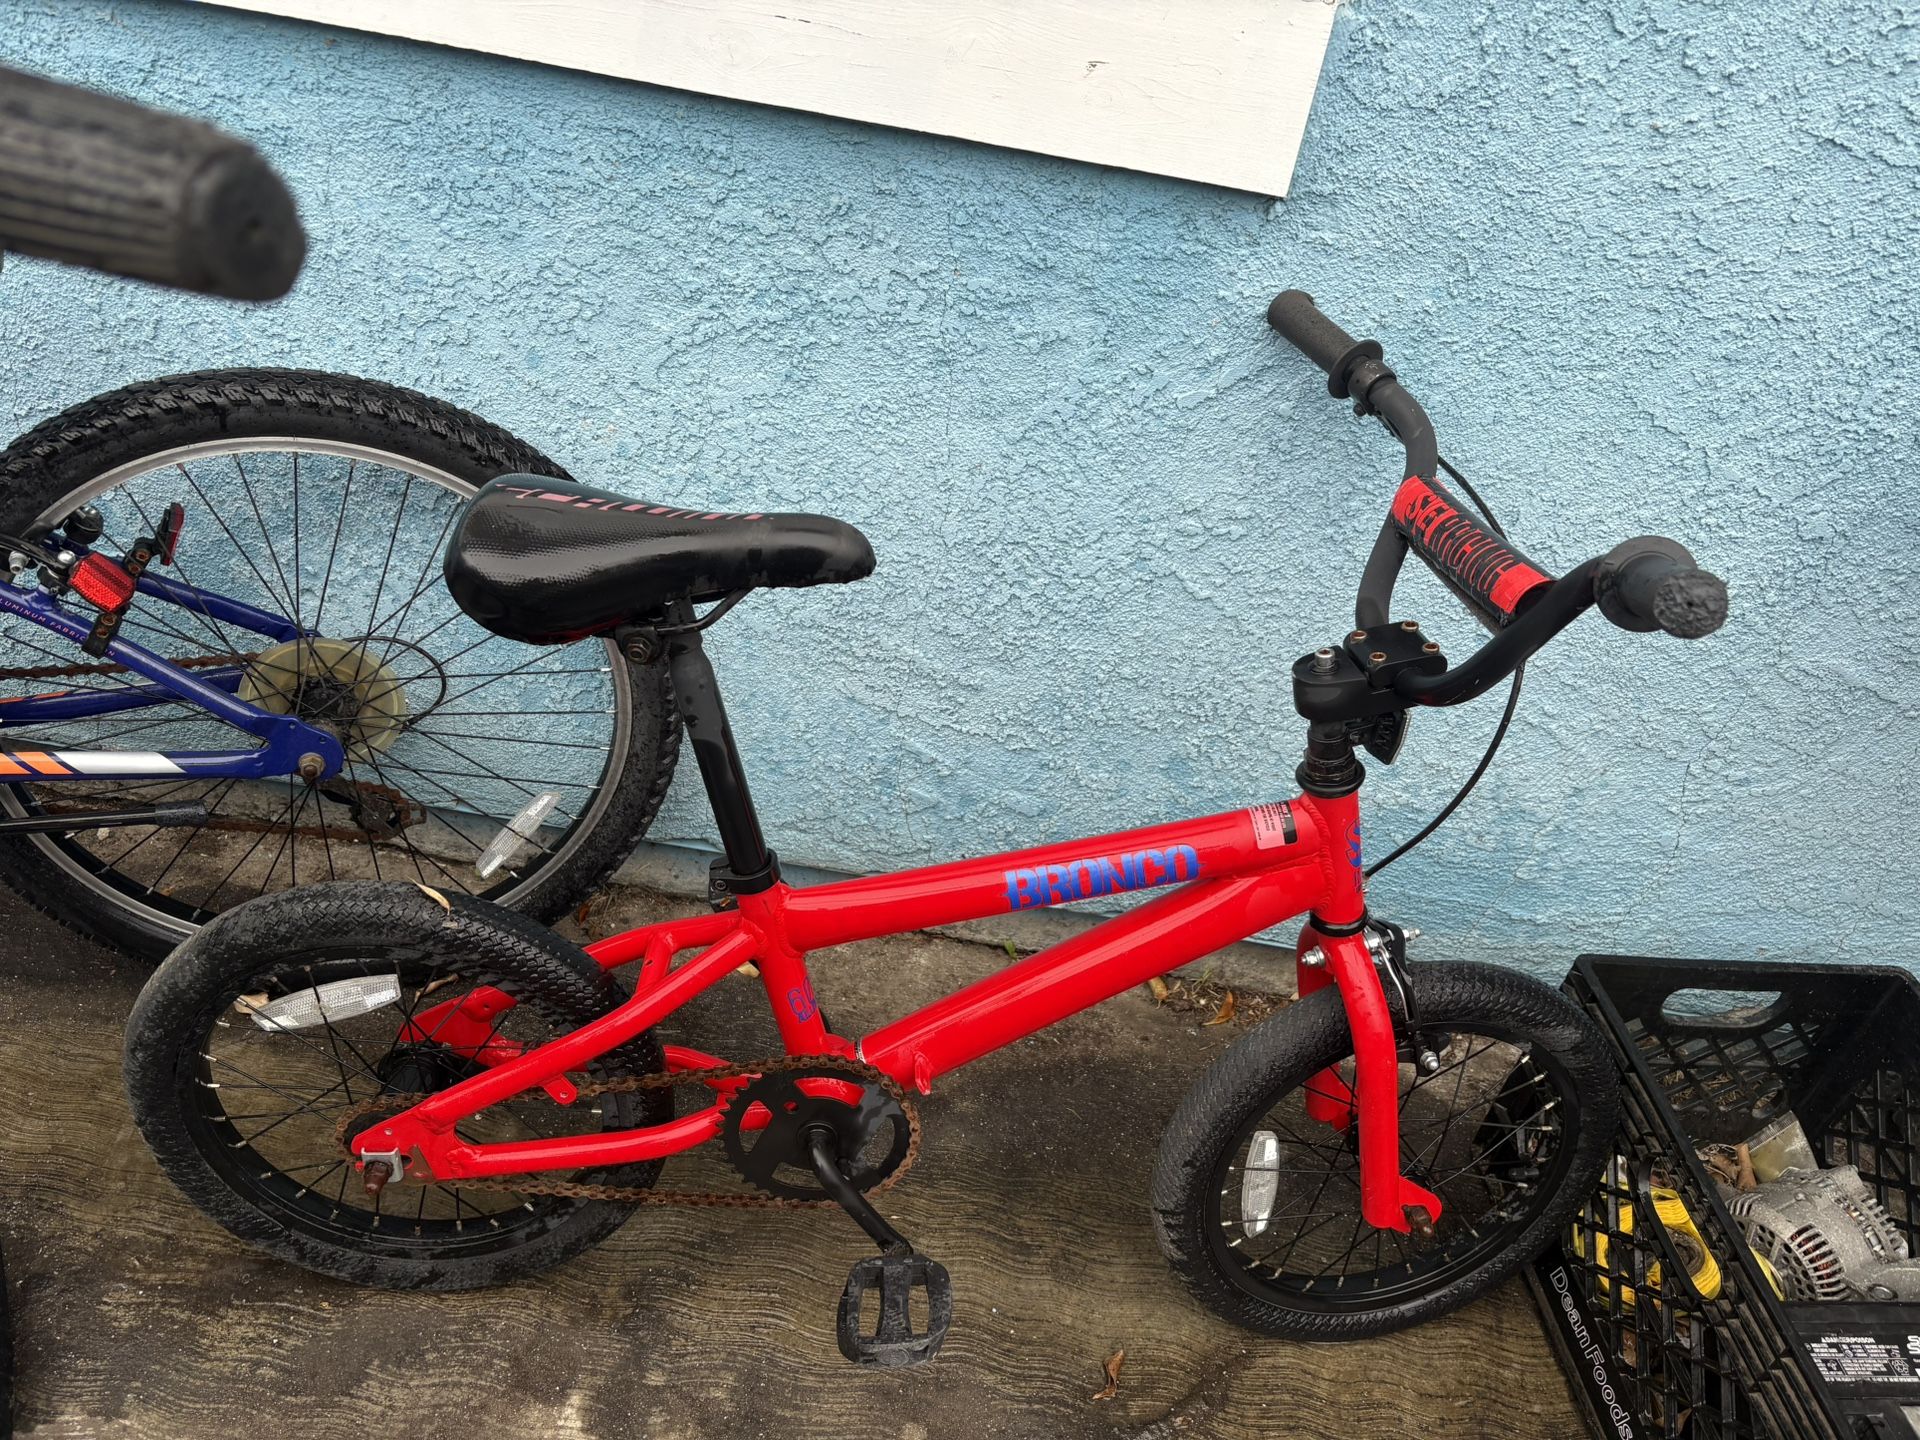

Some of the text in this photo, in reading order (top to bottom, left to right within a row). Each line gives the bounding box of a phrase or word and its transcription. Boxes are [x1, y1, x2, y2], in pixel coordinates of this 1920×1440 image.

[1004, 844, 1200, 912] BRONCO
[1549, 1265, 1633, 1440] Dean Foods
